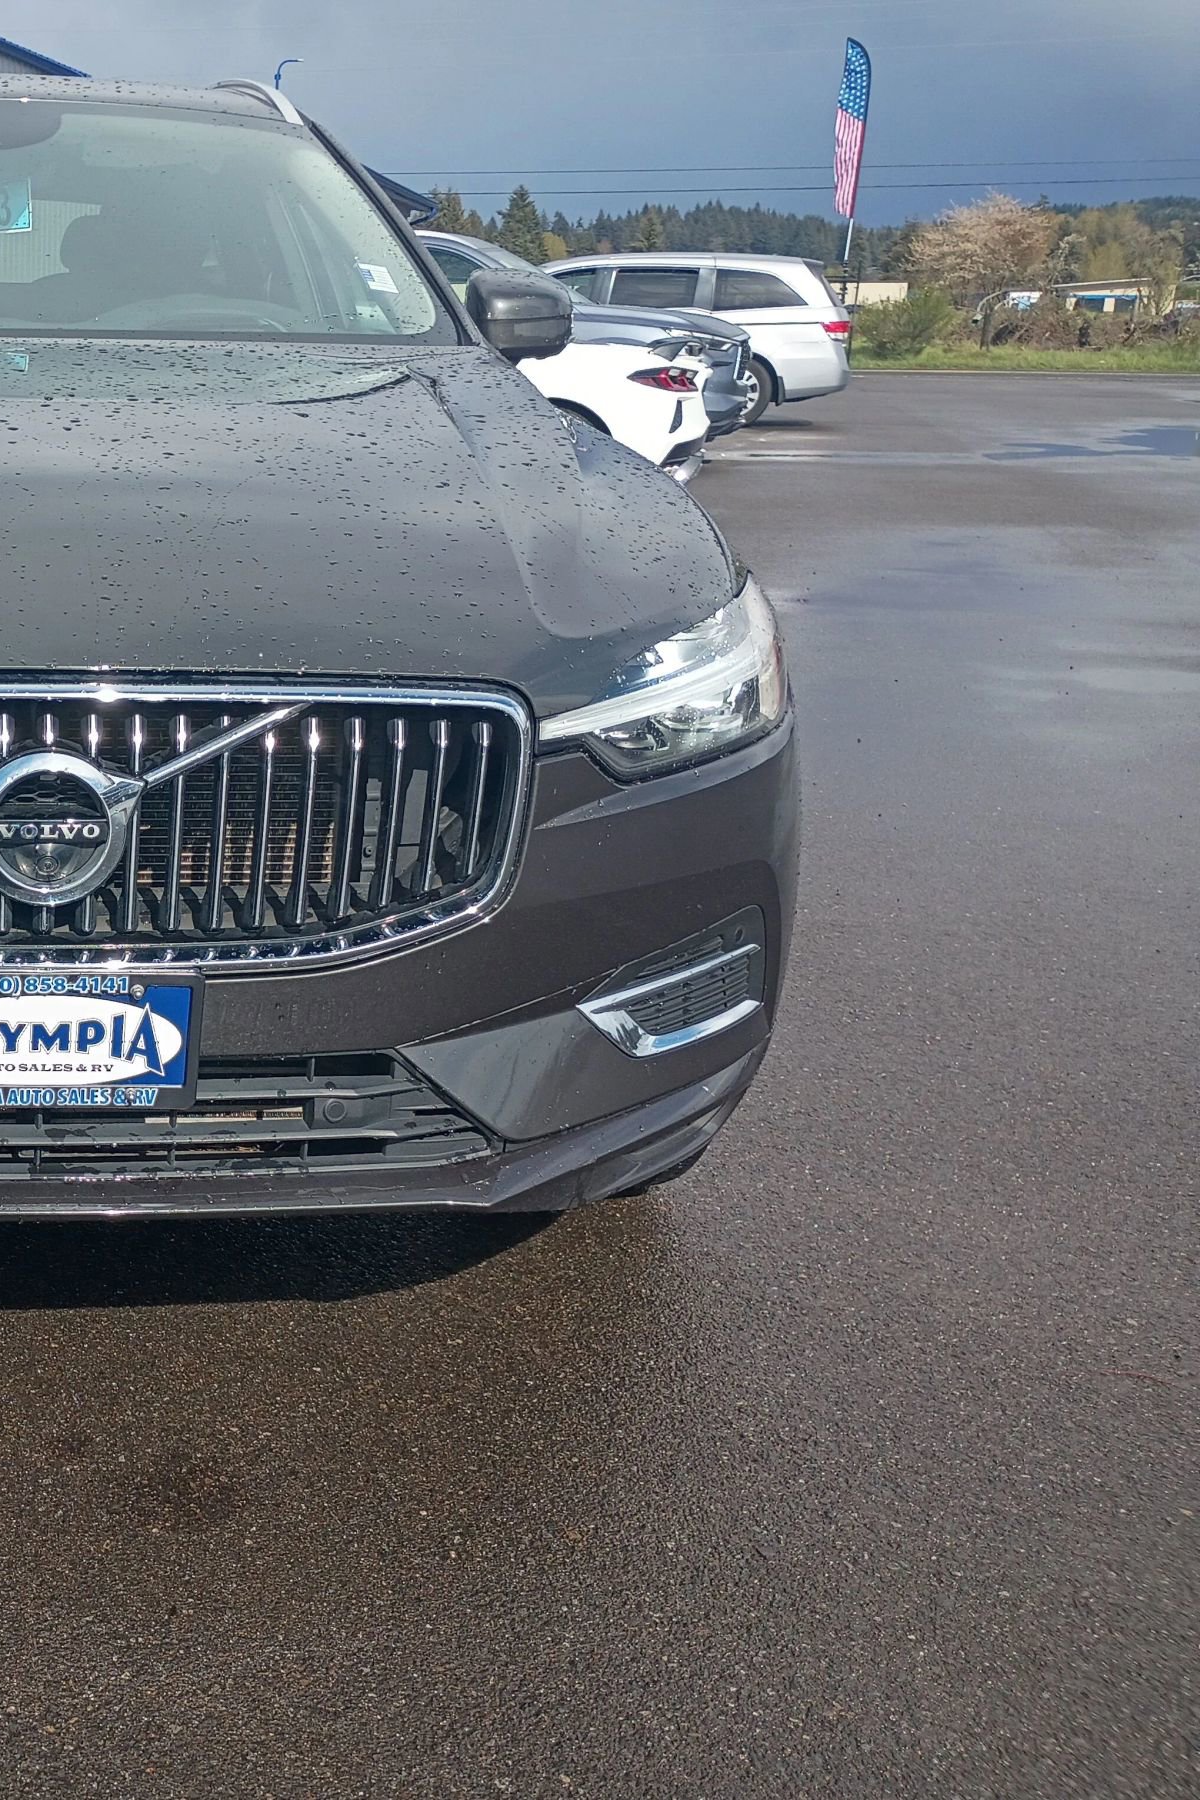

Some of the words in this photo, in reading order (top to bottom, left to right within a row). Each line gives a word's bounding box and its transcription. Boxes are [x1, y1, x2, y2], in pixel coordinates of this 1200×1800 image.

[23, 976, 129, 994] 858-4141
[18, 1063, 73, 1072] SALES
[76, 1064, 87, 1072] &
[90, 1064, 115, 1072] RV
[5, 1088, 55, 1106] AUTO
[57, 1088, 111, 1106] SALES
